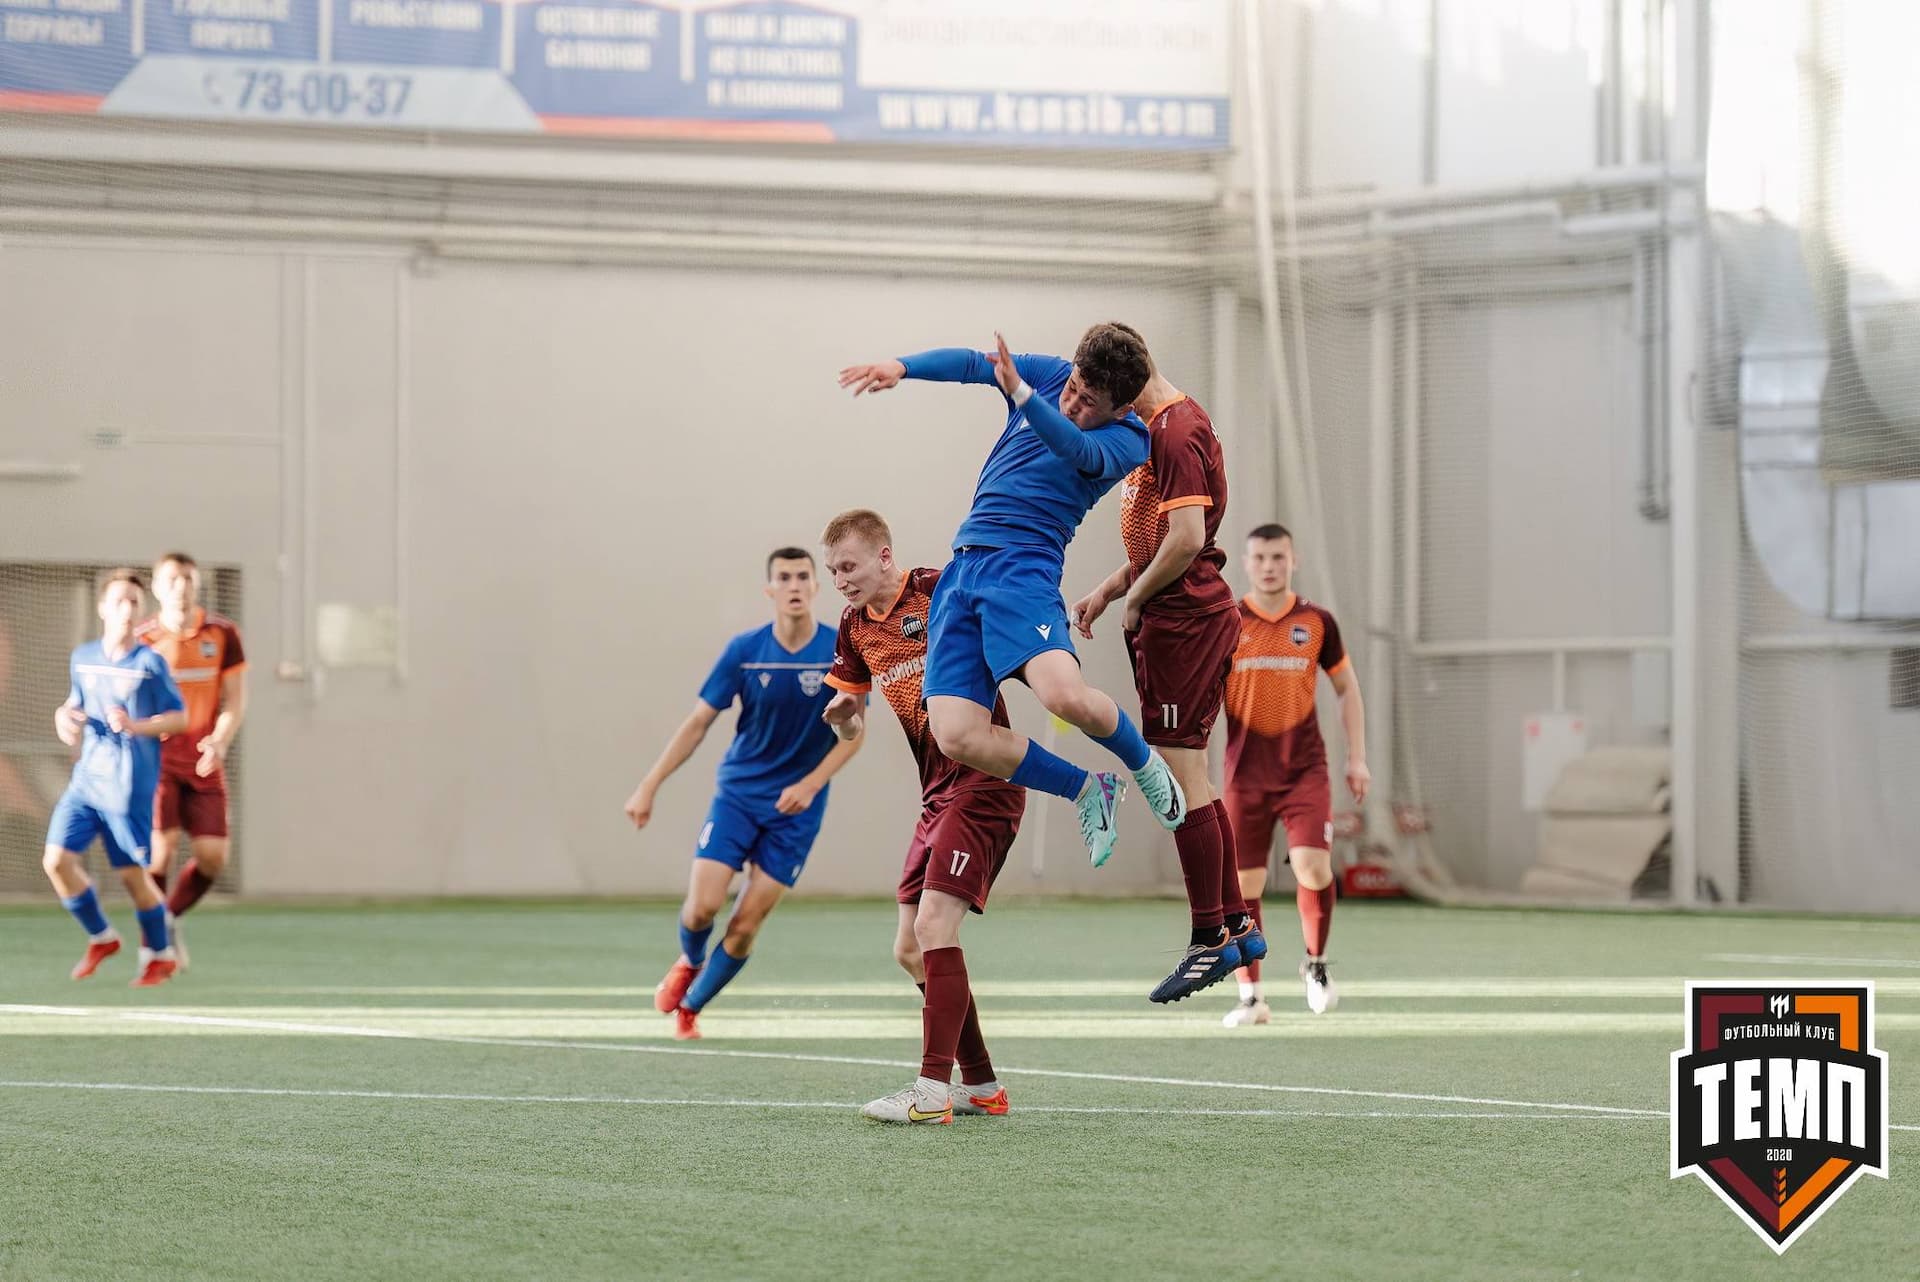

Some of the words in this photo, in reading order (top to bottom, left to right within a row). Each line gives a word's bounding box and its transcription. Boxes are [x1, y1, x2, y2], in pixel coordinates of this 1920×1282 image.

[235, 68, 414, 117] 73-00-37
[902, 619, 924, 636] ТЕМП
[1161, 703, 1178, 729] 11
[949, 849, 971, 877] 17
